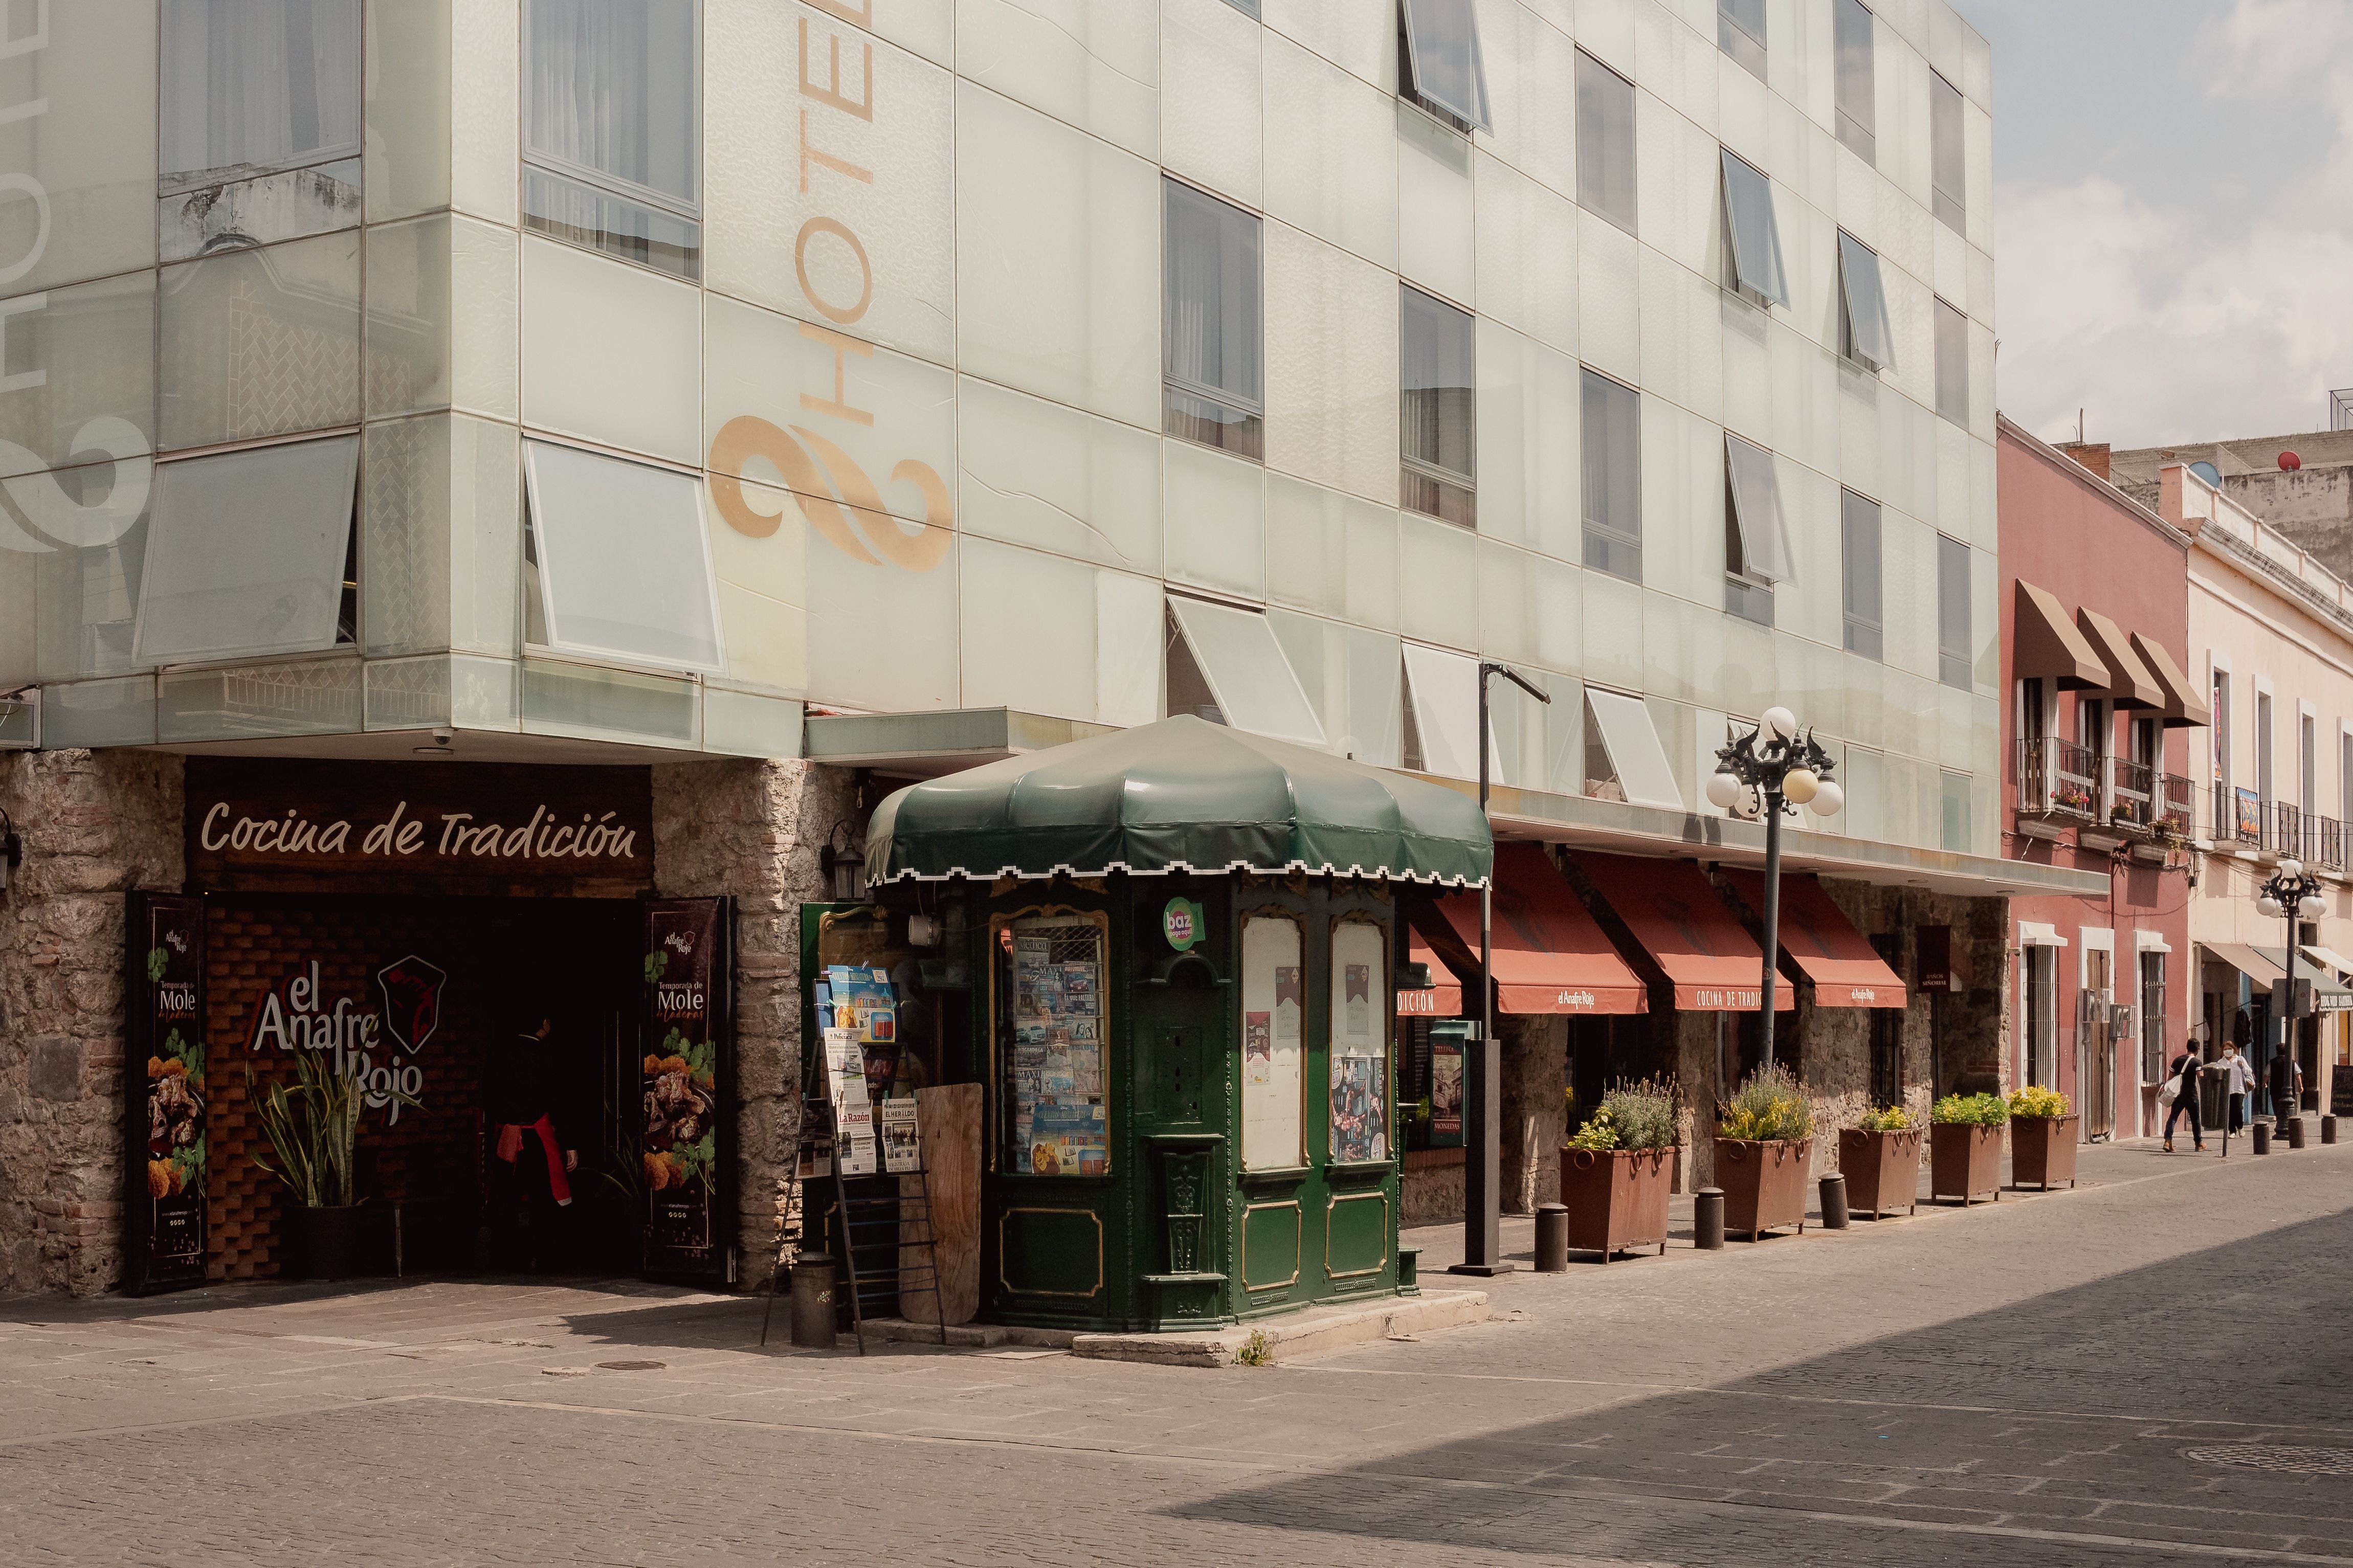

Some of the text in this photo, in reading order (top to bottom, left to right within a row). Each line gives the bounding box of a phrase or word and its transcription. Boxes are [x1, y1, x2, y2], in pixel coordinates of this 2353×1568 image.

[202, 801, 636, 858] Cocina de Tradición
[1166, 912, 1192, 930] baz
[166, 933, 181, 946] Anafre
[665, 936, 684, 948] Anafre
[678, 944, 691, 955] Rojo
[161, 980, 189, 990] Temporada
[291, 960, 319, 1012] el
[659, 982, 692, 990] Temporada
[161, 989, 195, 1011] Mole
[659, 989, 703, 1011] Mole
[1558, 990, 1594, 1010] el Anafre Rojo
[1697, 991, 1722, 1006] COCINA
[1726, 991, 1735, 1006] DE
[253, 992, 379, 1075] Anafre
[347, 1050, 423, 1126] Rojo
[839, 1112, 870, 1123] La Razón
